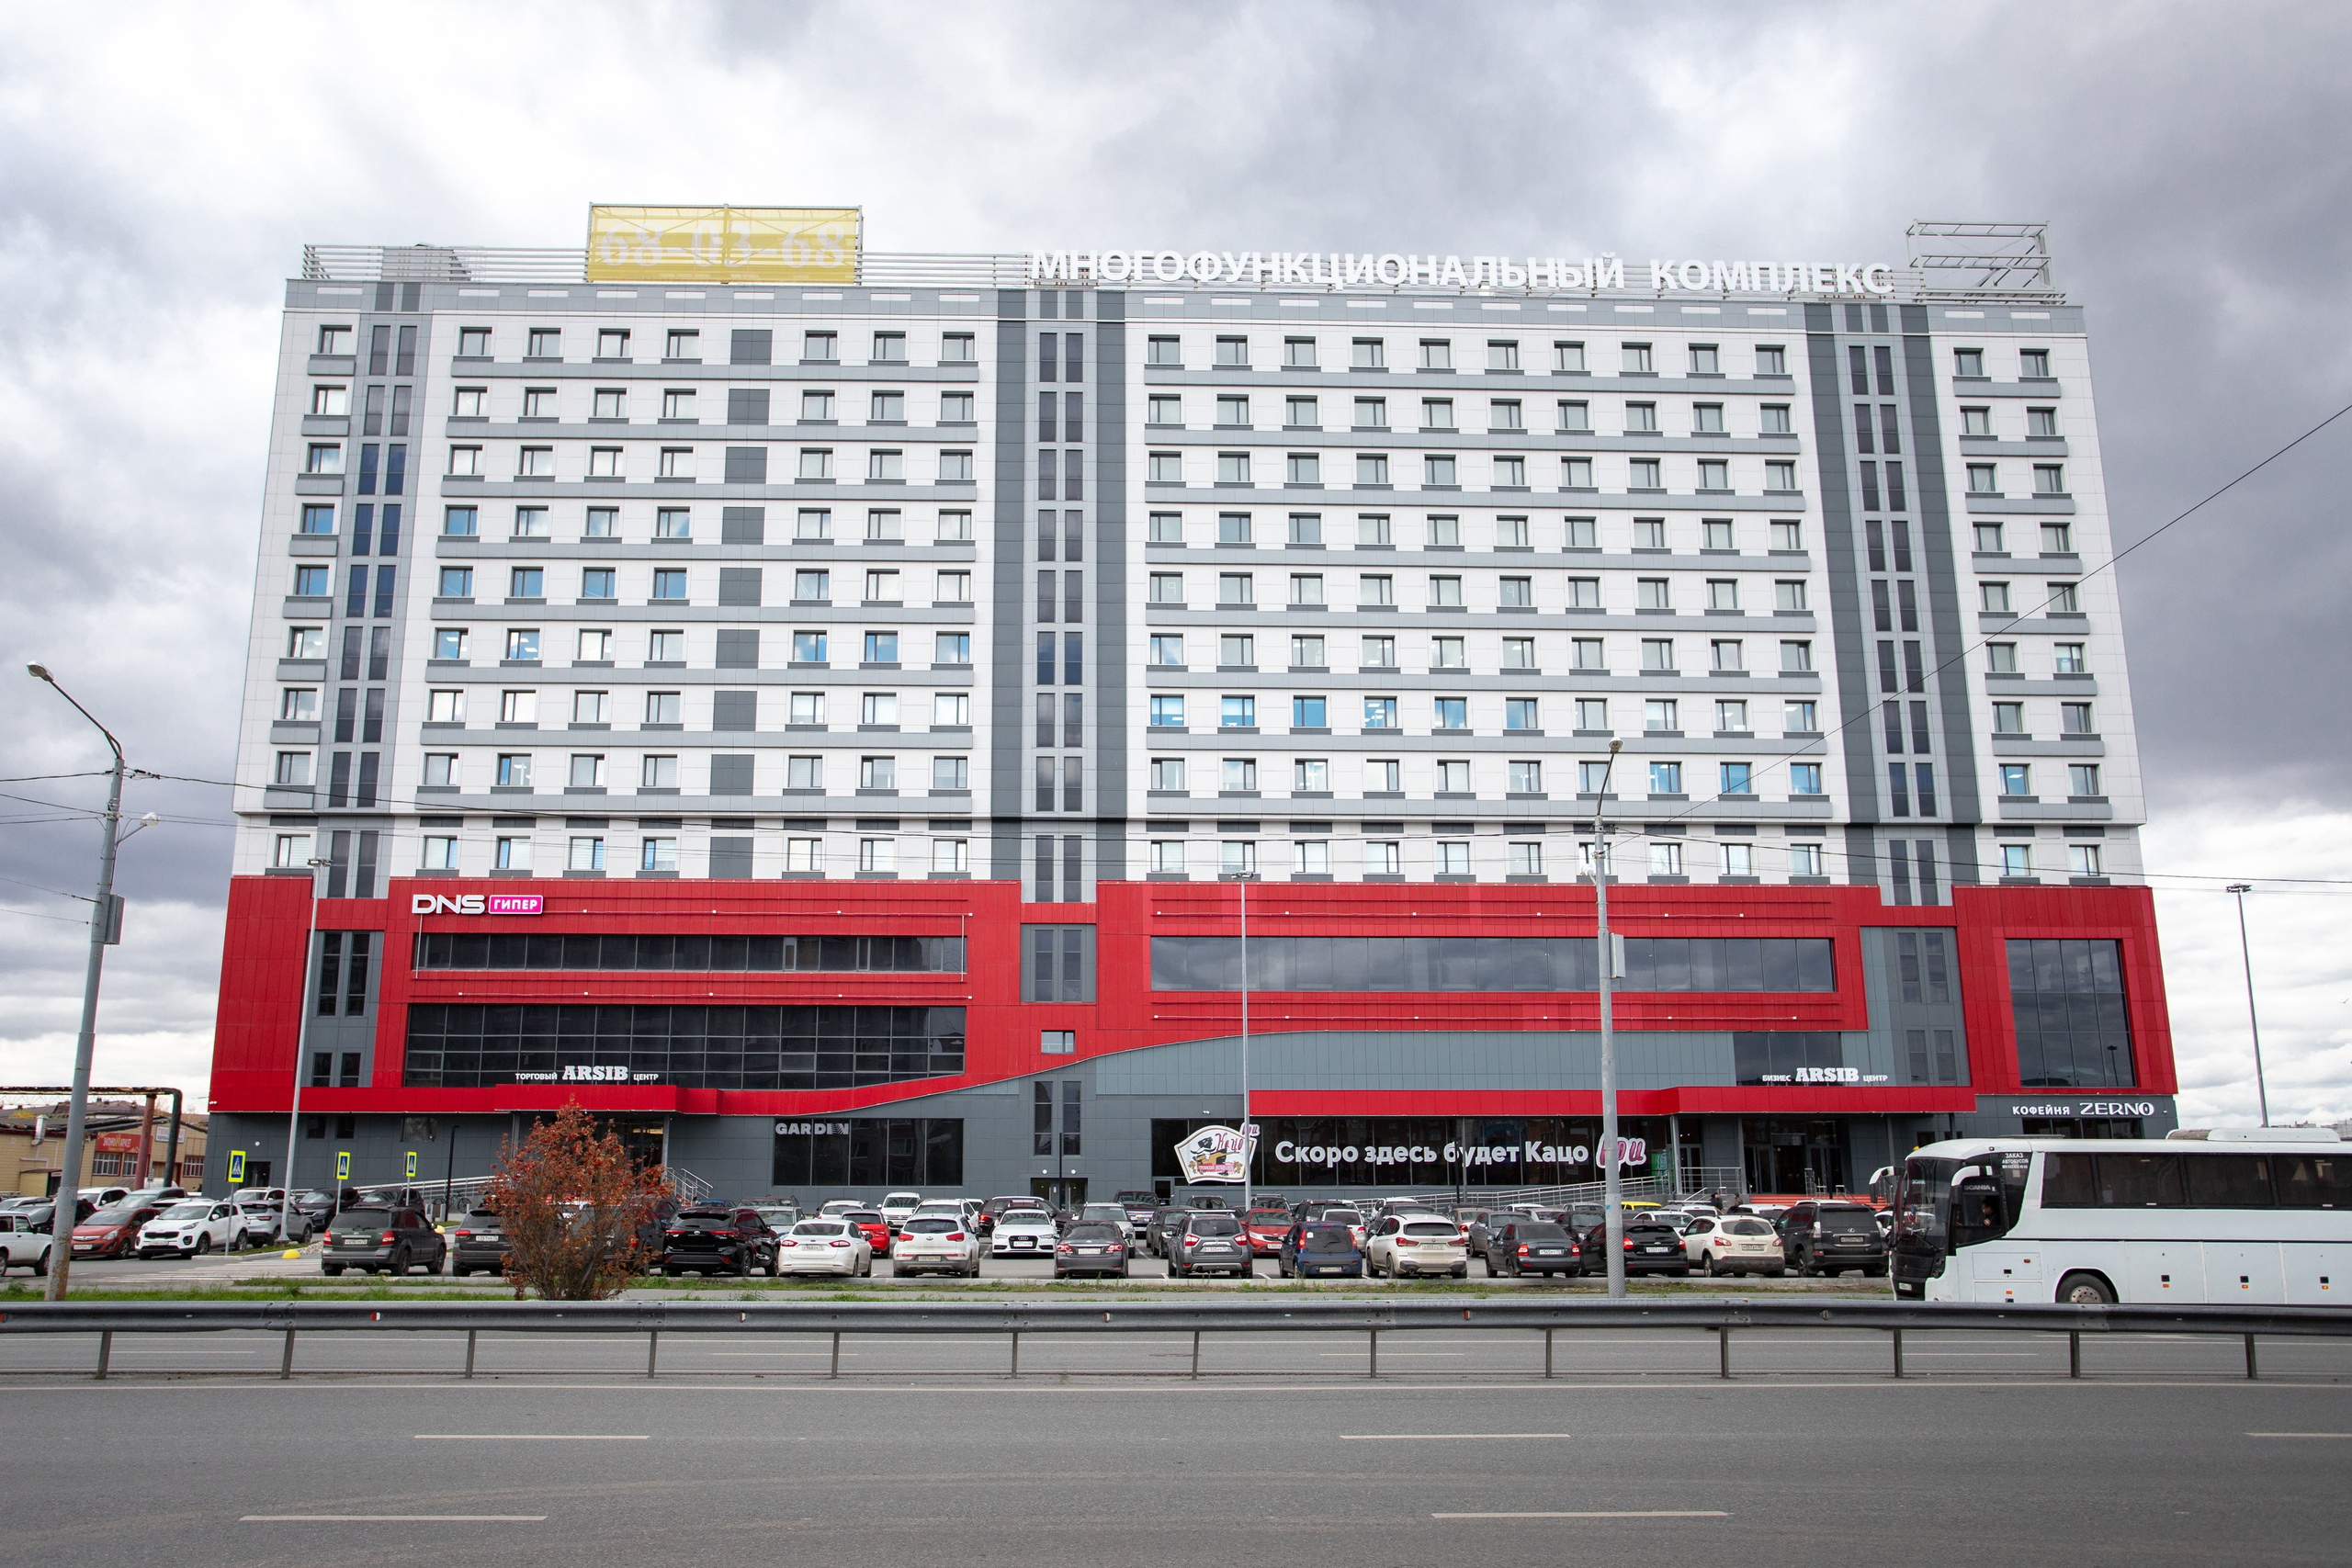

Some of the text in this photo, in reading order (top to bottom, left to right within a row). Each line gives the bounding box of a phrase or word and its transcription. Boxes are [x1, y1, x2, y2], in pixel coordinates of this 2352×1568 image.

[600, 222, 846, 268] 68-03-68
[1031, 250, 1894, 295] МНОГОФУНКЦИОНАЛЬНЫЙ КОМПЛЕКС
[412, 895, 538, 914] DNS ГИПЕР
[515, 1066, 659, 1081] ТОРГОВЫЙ ARSIB ЦЕНТР
[1795, 1067, 1860, 1082] ARSIB
[1863, 1075, 1889, 1083] ЦЕНТР
[2012, 1102, 2154, 1116] КОФЕЙНЯ ZERNO
[1275, 1141, 1359, 1168] Скоро
[1364, 1145, 1437, 1165] здесь
[1443, 1141, 1520, 1168] будет
[1525, 1141, 1589, 1165] Кацо
